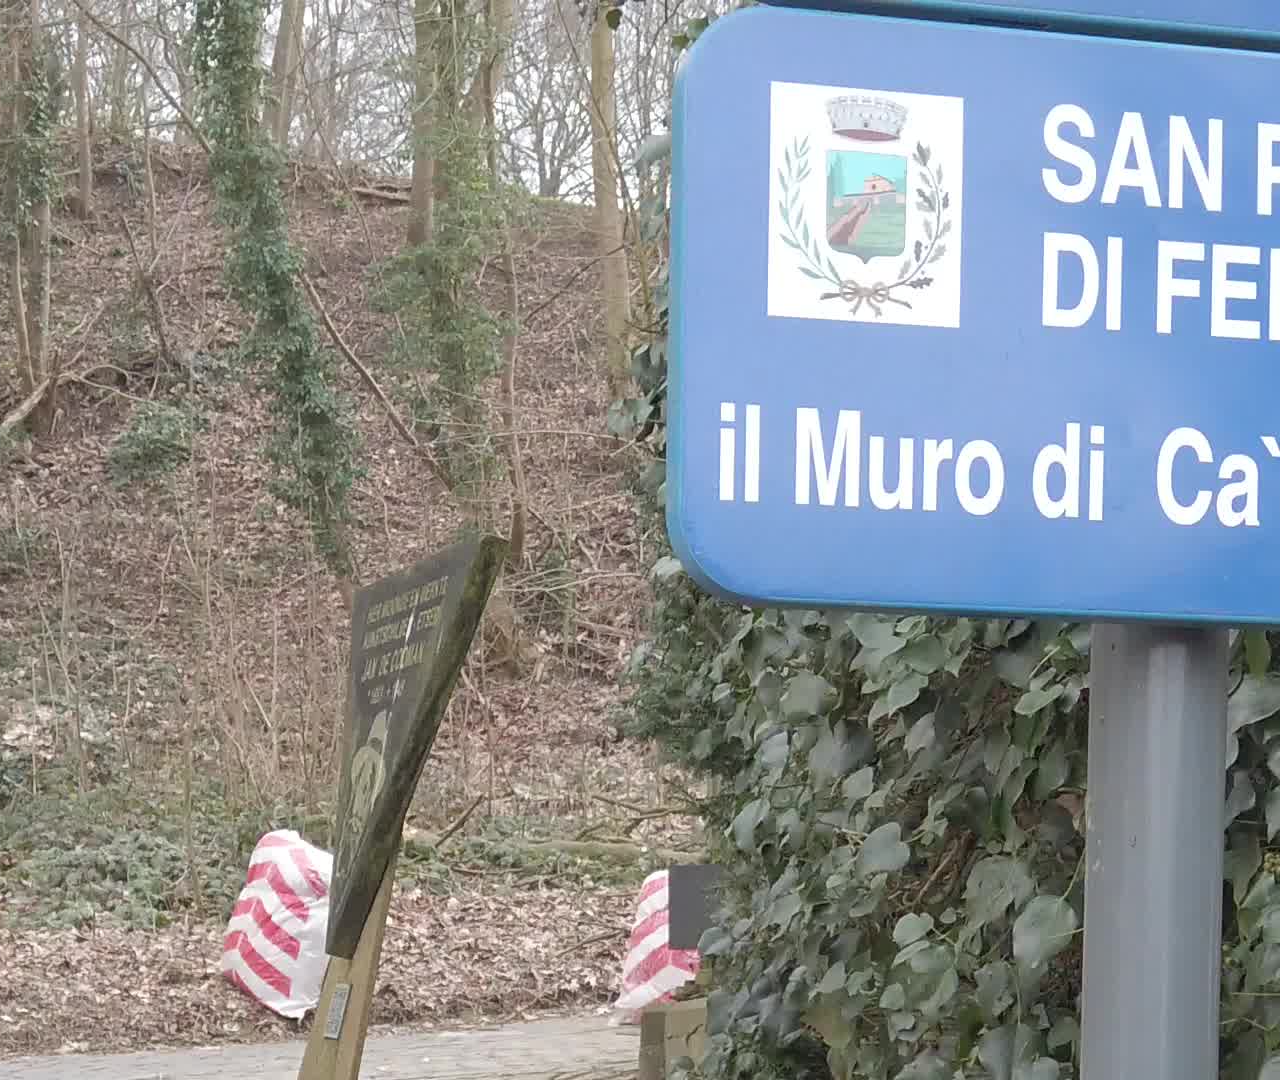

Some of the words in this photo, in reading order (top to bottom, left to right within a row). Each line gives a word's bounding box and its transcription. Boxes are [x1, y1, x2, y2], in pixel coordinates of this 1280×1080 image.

[1039, 103, 1226, 213] SAN
[1039, 230, 1125, 333] DI
[718, 400, 763, 506] il
[793, 406, 1006, 517] Muro
[1031, 421, 1106, 523] di
